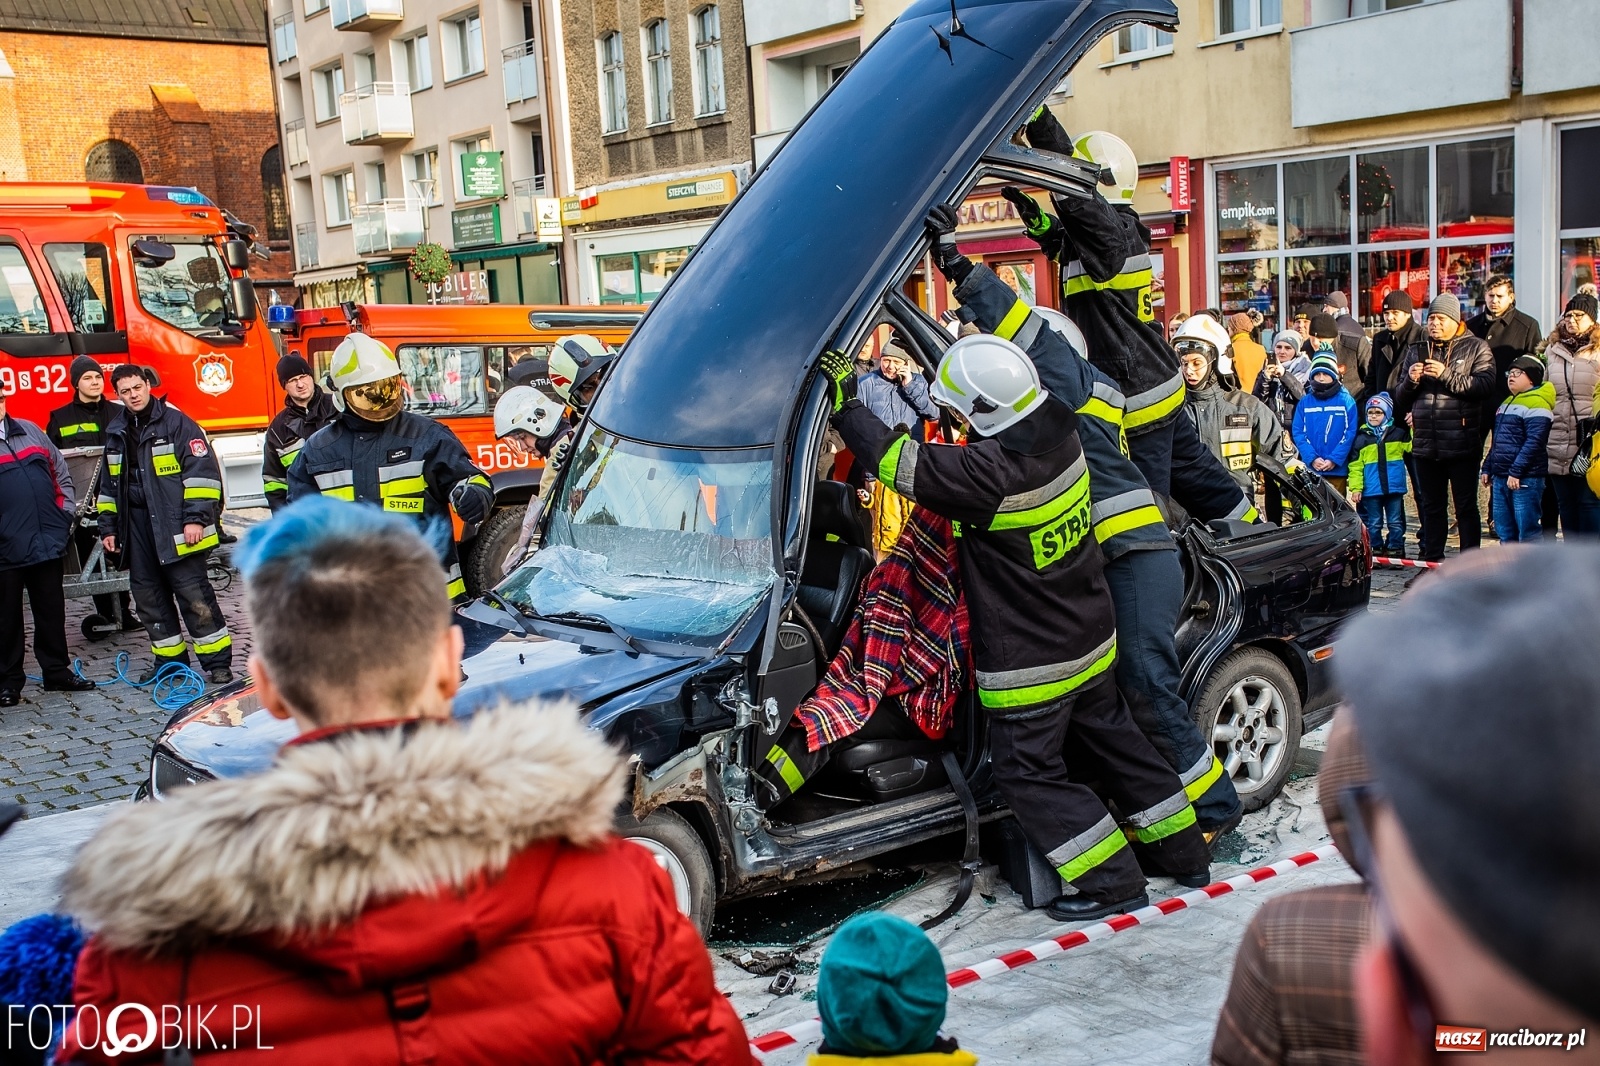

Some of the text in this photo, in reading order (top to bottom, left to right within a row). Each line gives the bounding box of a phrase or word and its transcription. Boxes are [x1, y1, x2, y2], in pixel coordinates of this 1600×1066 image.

[668, 181, 723, 198] STEFCZYK FINANSE
[705, 194, 725, 202] PARTNER
[1221, 201, 1275, 220] empik.com
[33, 364, 68, 394] 32
[530, 378, 553, 388] STRA
